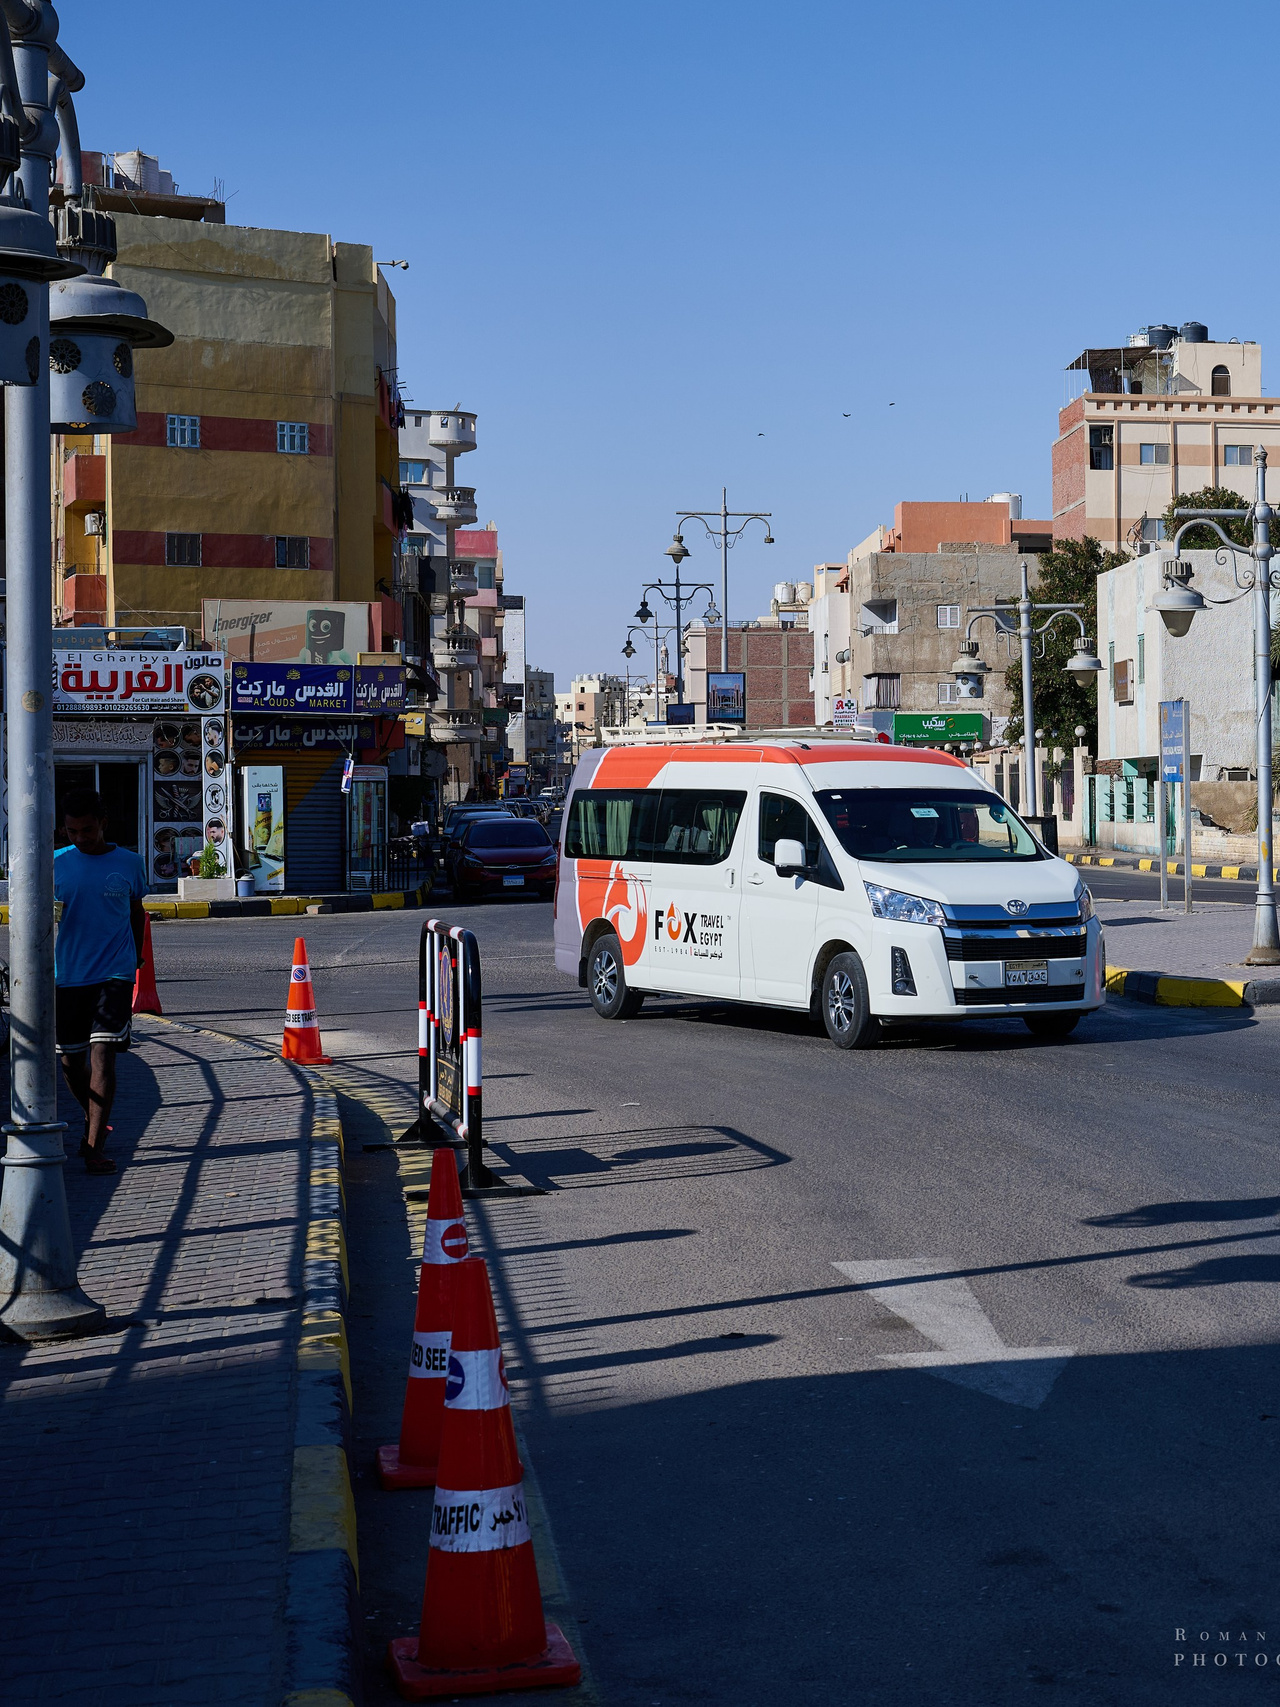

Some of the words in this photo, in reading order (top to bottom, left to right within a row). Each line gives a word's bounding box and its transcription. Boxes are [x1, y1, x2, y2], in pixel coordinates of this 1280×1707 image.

[212, 611, 273, 634] Energizer
[67, 653, 82, 662] El
[94, 653, 170, 665] Gharbya
[184, 655, 222, 670] صالون
[61, 663, 184, 700] الغربية
[236, 680, 287, 702] ماركت
[295, 681, 345, 703] القدس
[356, 682, 378, 703] ماركت
[380, 682, 404, 704] القدس
[253, 698, 265, 707] AL
[269, 698, 296, 708] QUDS
[309, 699, 347, 709] MARKET
[386, 700, 404, 708] MARKET
[234, 724, 292, 748] ماركت
[303, 724, 359, 748] القدس
[700, 914, 724, 929] TRAVEL
[700, 932, 723, 947] EGYPT
[292, 1013, 301, 1023] SEE
[425, 1347, 447, 1371] SEE
